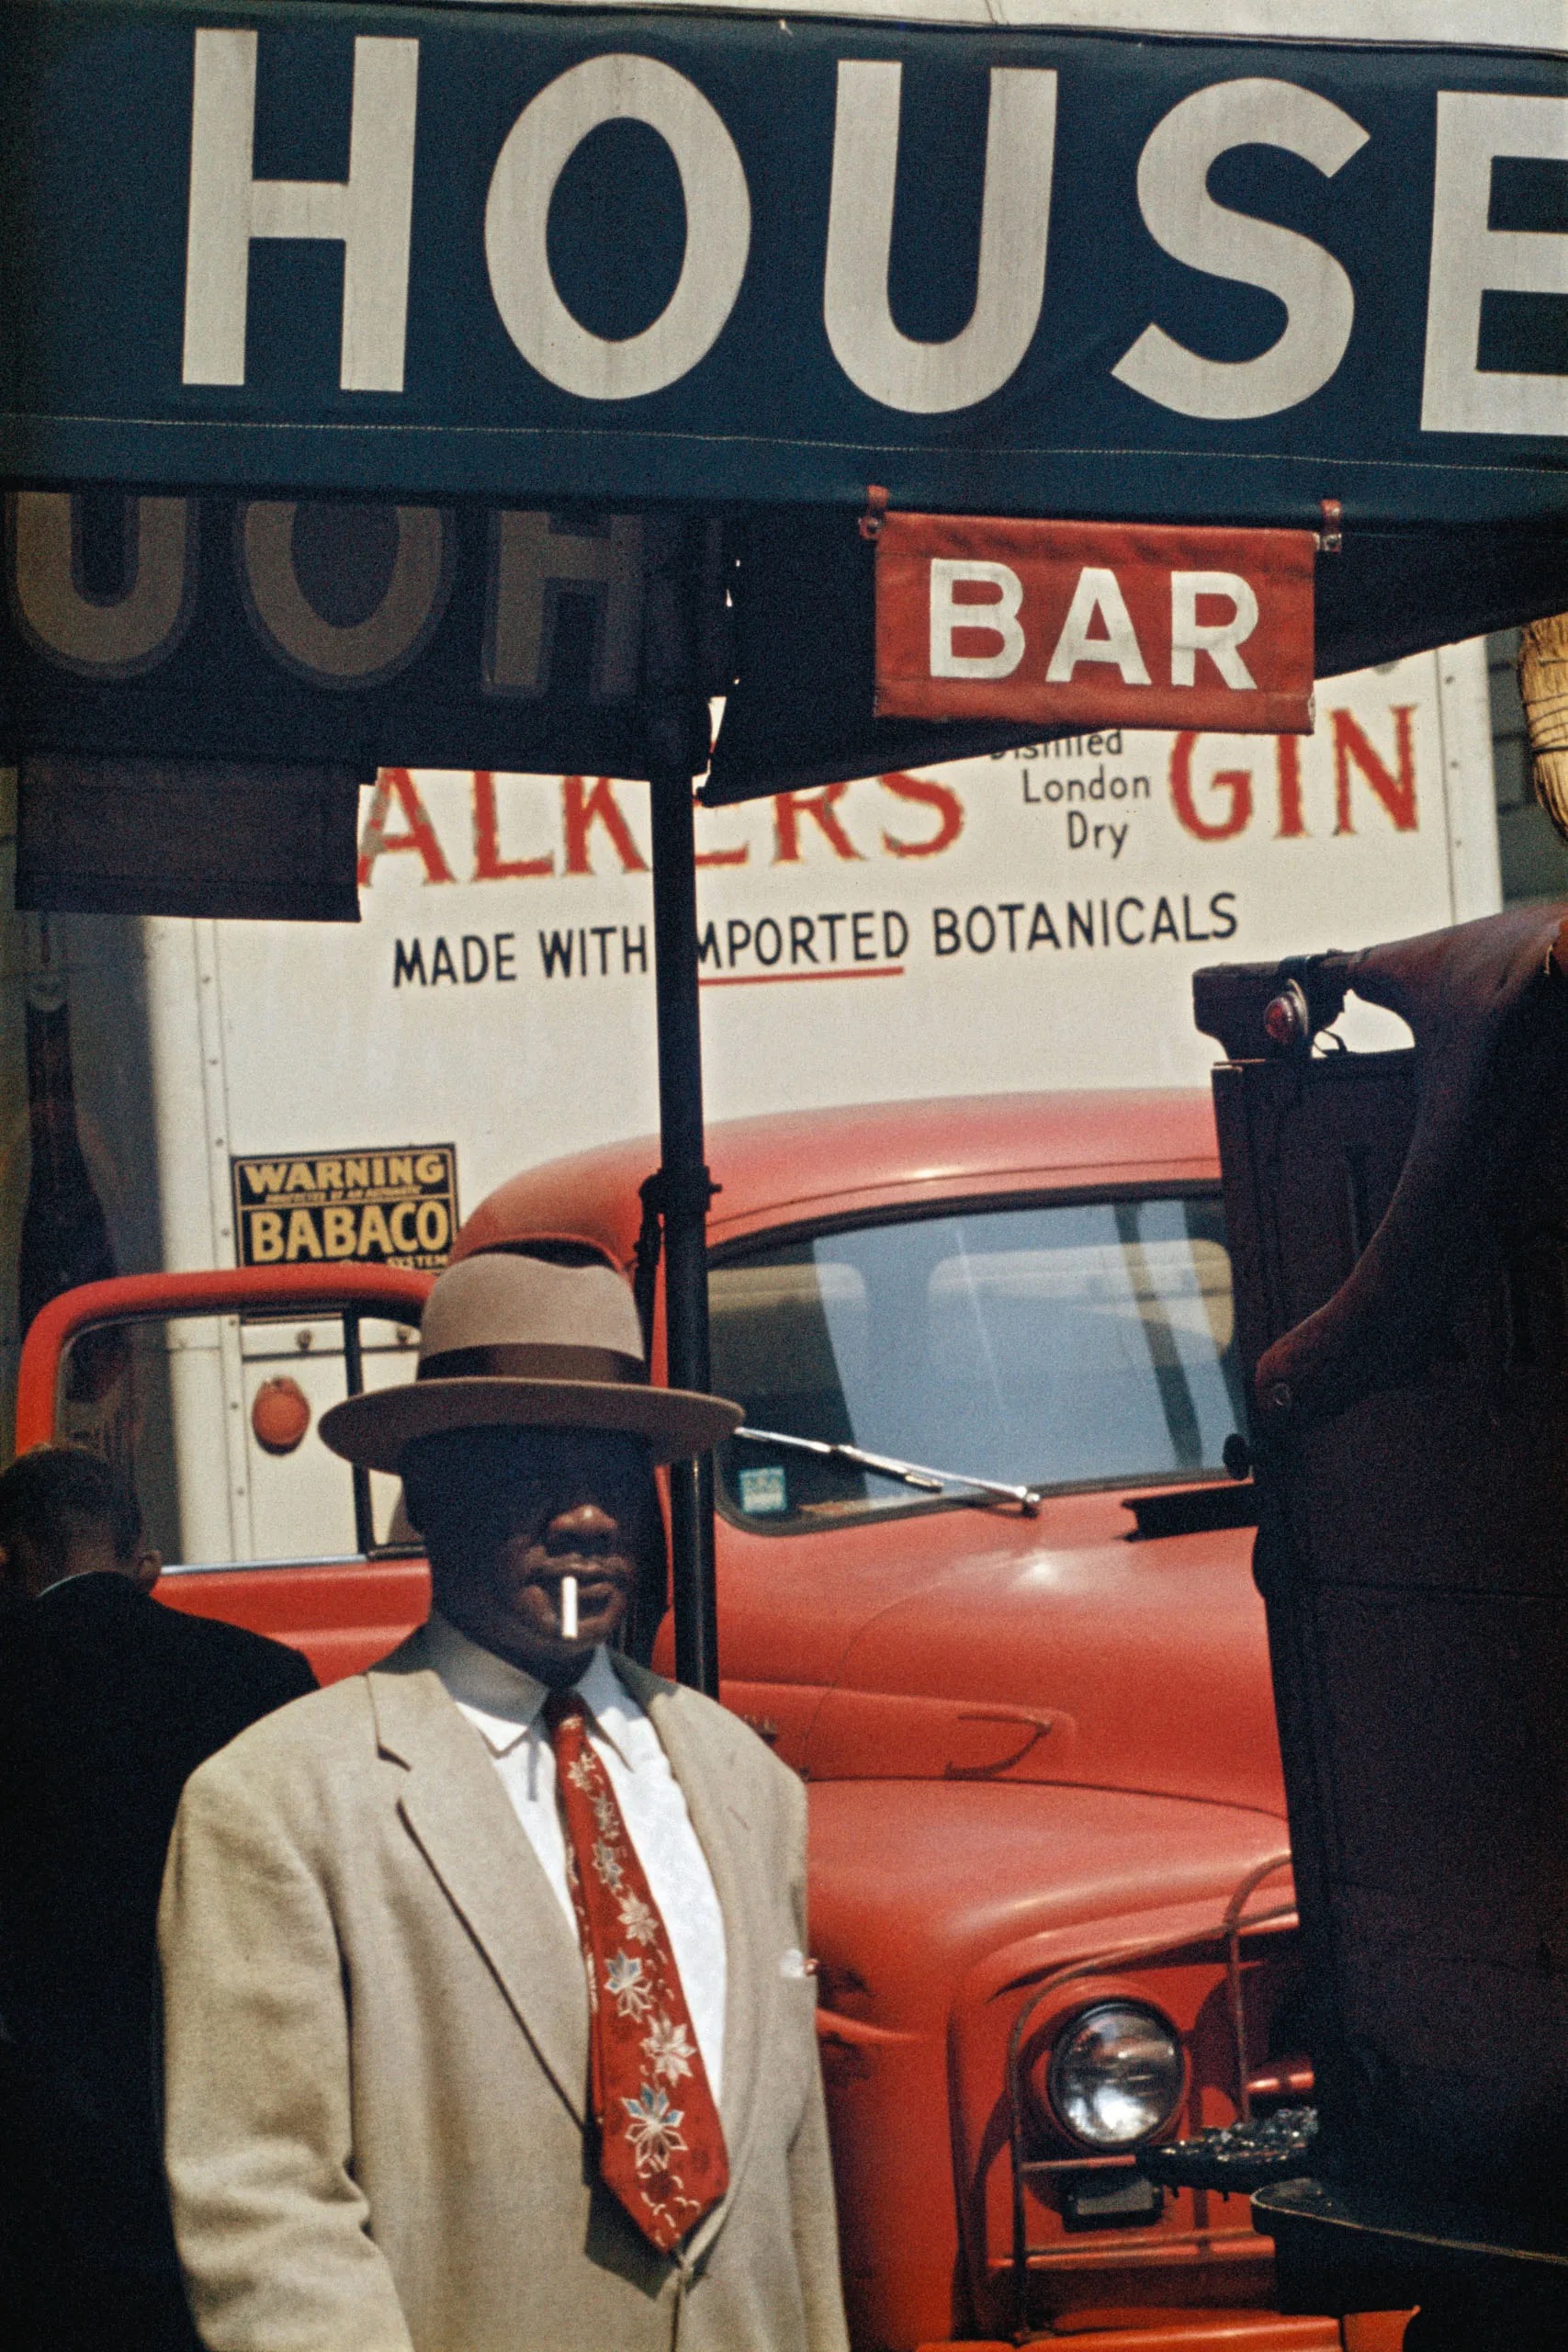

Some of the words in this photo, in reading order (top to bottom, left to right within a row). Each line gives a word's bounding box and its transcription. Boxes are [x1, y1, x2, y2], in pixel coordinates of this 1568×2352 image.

[182, 28, 1568, 435] HOUSE
[930, 558, 1258, 690] BAR
[1022, 763, 1150, 804] London
[1168, 705, 1418, 842] GIN
[1066, 809, 1129, 860] Dry
[393, 933, 517, 988] MADE
[538, 925, 648, 979] WITH
[694, 910, 908, 969] MPORTED
[932, 892, 1237, 956] BOTANICALS
[244, 1154, 445, 1194] WARNING
[251, 1201, 448, 1263] BABACO
